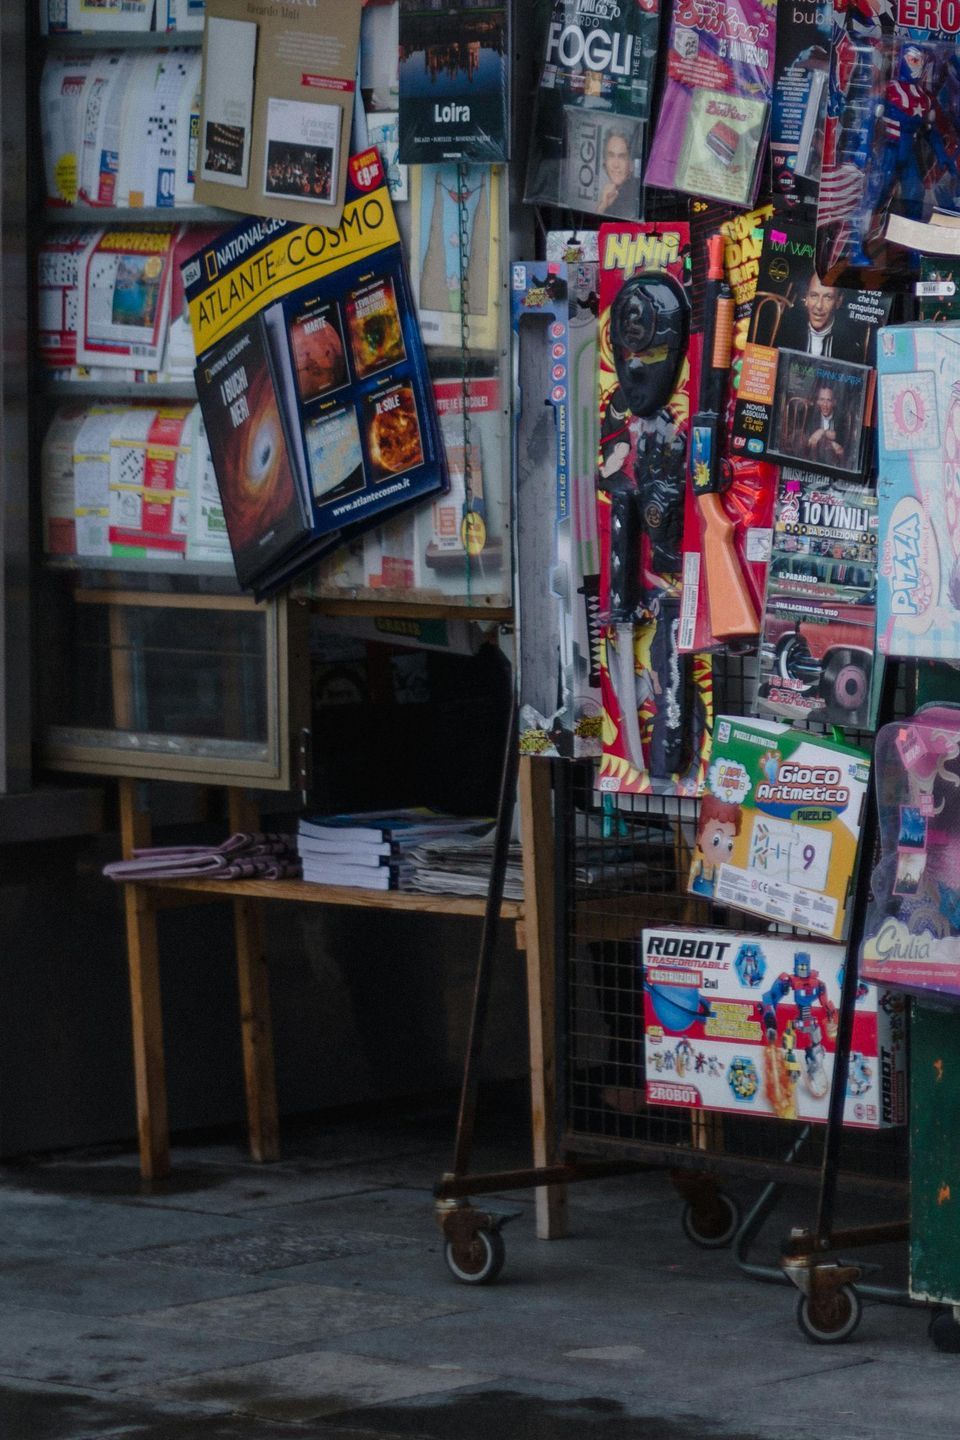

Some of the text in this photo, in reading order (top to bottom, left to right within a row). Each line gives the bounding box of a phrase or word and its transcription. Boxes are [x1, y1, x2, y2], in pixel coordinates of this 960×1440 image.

[551, 12, 600, 28] RICCARDO
[792, 8, 833, 26] bub
[545, 22, 633, 76] FOGLI
[632, 35, 642, 76] THE BEST
[434, 102, 471, 123] Loira
[578, 122, 596, 201] FOGLI
[693, 201, 708, 212] 3+
[217, 224, 265, 266] NATIONAL
[788, 241, 815, 257] WAY
[197, 250, 277, 331] ATLANTE
[286, 198, 384, 266] COSMO
[185, 267, 198, 283] RBA
[848, 302, 885, 317] conquistato
[858, 295, 868, 305] che
[303, 316, 327, 336] MARTE
[226, 365, 249, 402] BUCHI
[383, 394, 401, 413] SOLE
[745, 403, 766, 414] NOVITÀ
[741, 409, 768, 421] ASSOLUTA
[559, 434, 567, 467] EFFETTI
[559, 473, 567, 490] LED
[332, 477, 411, 518] www.atlantecosmo.it
[804, 502, 869, 532] 10 VINILI
[819, 529, 859, 542] COLLEZIONE
[891, 511, 920, 615] PIZZA
[785, 572, 818, 583] PARADISO
[788, 603, 813, 614] LACRIMA
[823, 608, 839, 617] VISO
[777, 764, 840, 786] Gioco
[756, 783, 848, 803] Aritmetico
[797, 810, 832, 822] PUZZLES
[802, 843, 816, 871] 9
[646, 936, 731, 961] ROBOT
[875, 923, 931, 967] Giulia
[645, 955, 731, 971] TRASFORMABILE
[881, 1046, 892, 1124] ROBOT
[651, 1086, 698, 1105] 2ROBOT
